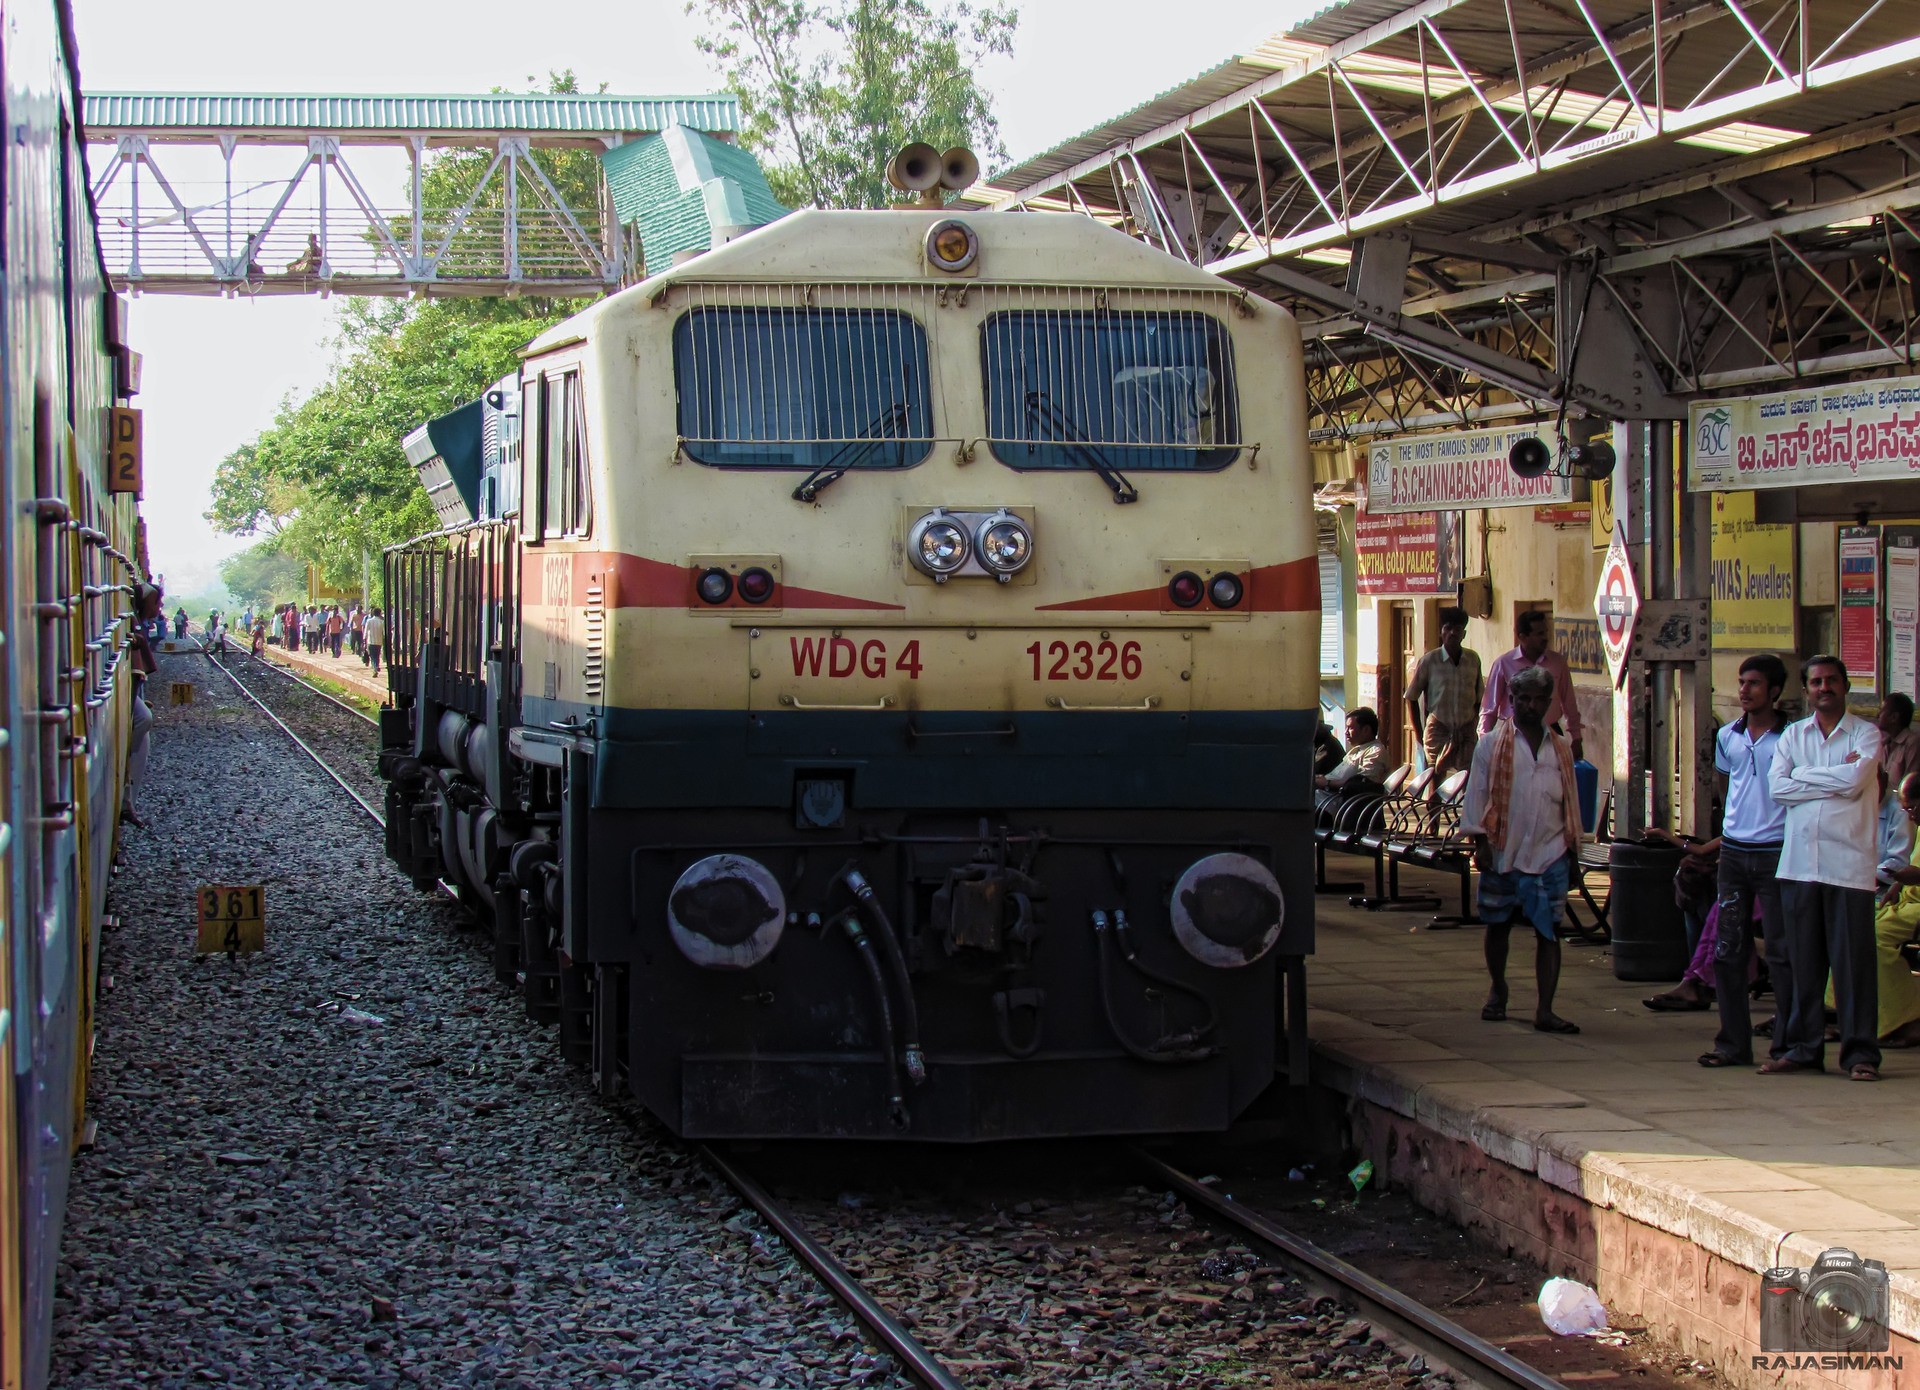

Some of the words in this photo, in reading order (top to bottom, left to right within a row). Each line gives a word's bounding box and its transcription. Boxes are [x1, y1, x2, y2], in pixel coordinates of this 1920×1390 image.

[1399, 445, 1411, 461] THE
[1415, 442, 1434, 459] MOST
[1438, 439, 1466, 457] FAMOUS
[1471, 436, 1490, 454] SHOP
[1494, 434, 1502, 451] IN
[1698, 422, 1731, 455] BSC
[1357, 552, 1384, 575] GUPTHA
[1386, 551, 1405, 574] GOLD
[1406, 550, 1435, 573] PALACE
[546, 557, 569, 606] 12326
[1744, 563, 1792, 600] Jewellers
[1026, 640, 1142, 681] 12326
[203, 889, 259, 919] 361
[224, 921, 241, 951] 4
